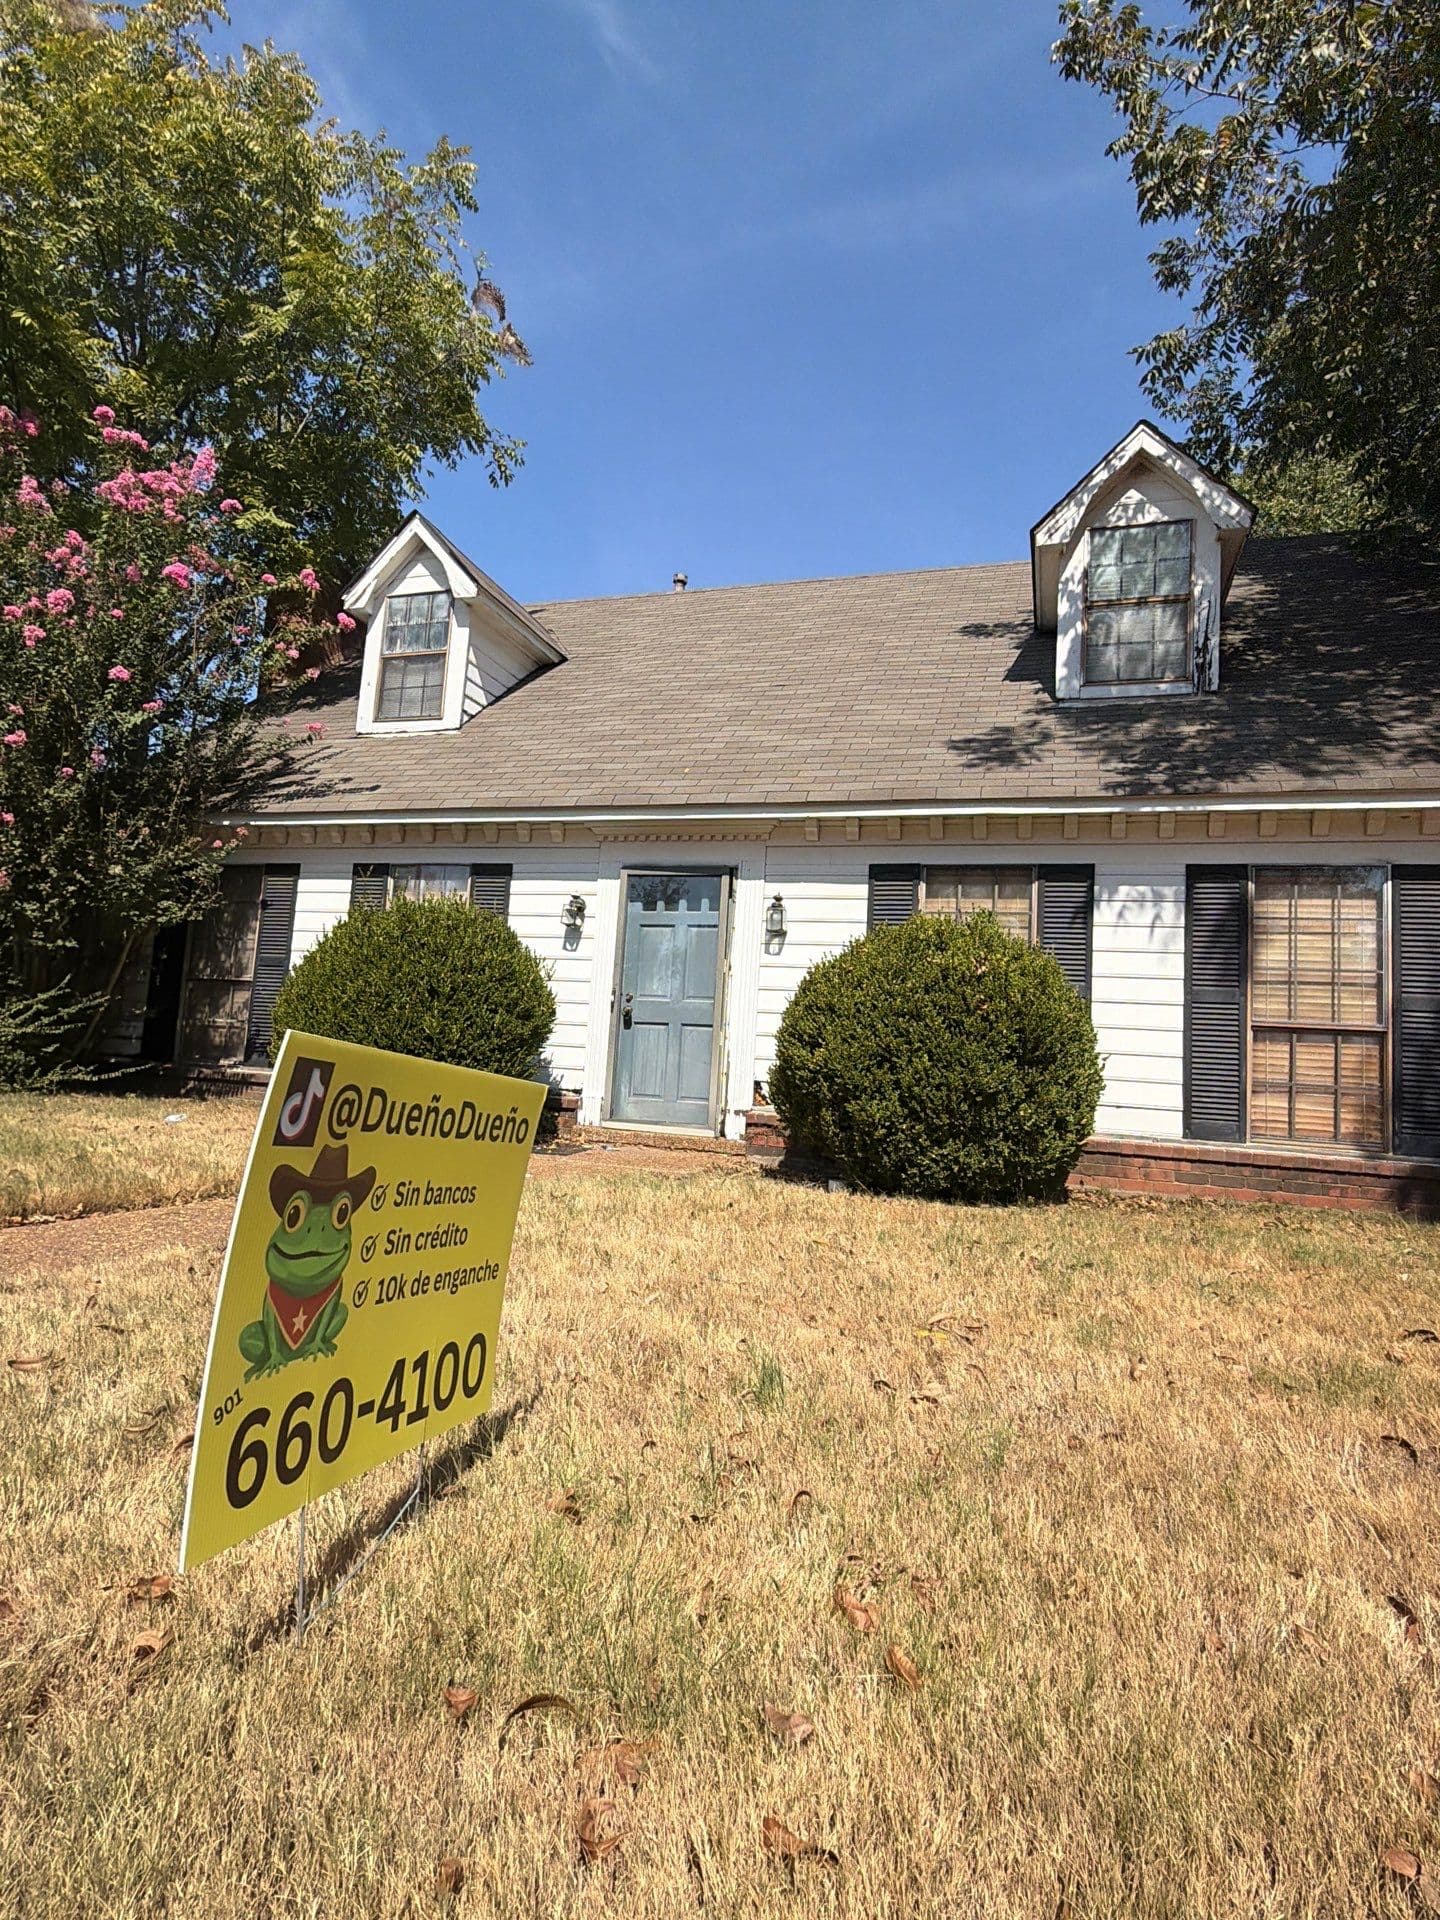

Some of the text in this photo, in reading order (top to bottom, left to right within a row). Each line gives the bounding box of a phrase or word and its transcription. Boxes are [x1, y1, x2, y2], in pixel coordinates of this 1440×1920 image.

[327, 1084, 530, 1145] @DueñoDueño
[392, 1180, 477, 1208] Sin bancos
[383, 1223, 468, 1256] Sin crédito
[374, 1259, 500, 1306] 10k de enganche
[213, 1332, 487, 1509] 901 660-4100
